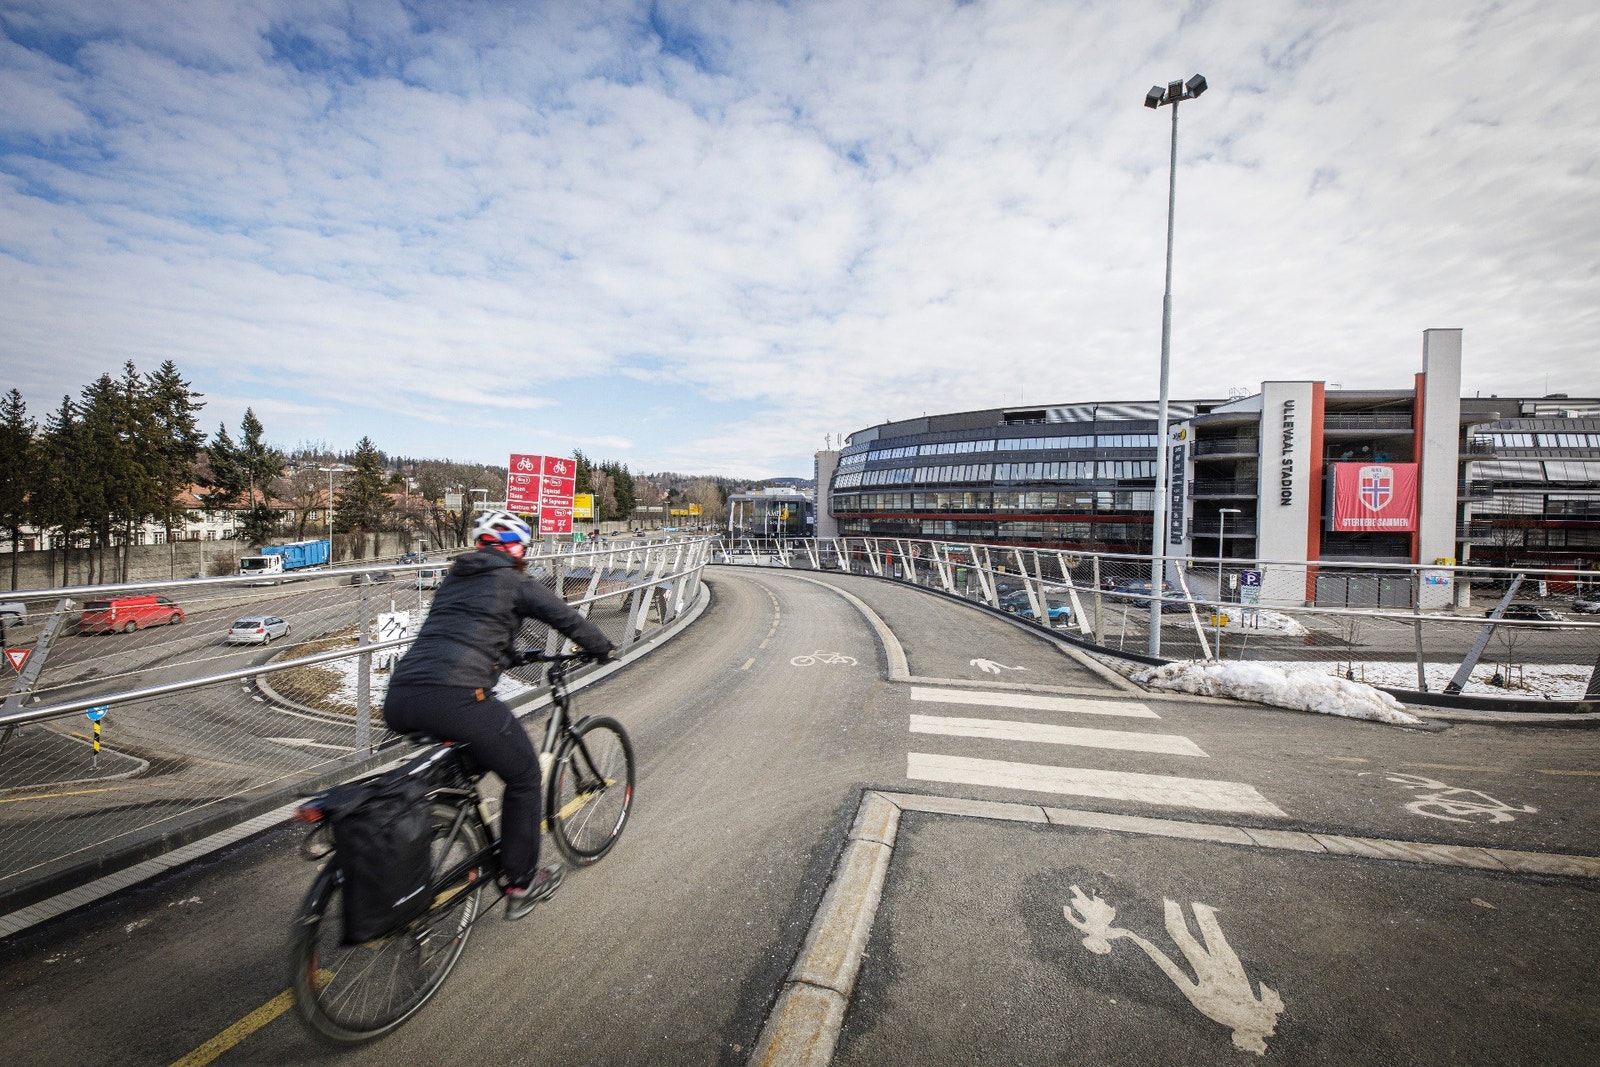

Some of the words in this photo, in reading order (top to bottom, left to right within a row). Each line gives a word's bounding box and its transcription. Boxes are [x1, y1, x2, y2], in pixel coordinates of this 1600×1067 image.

[1282, 399, 1295, 455] ULLEVAAL
[1280, 458, 1293, 506] STADION
[1342, 518, 1375, 527] STERKERE
[1378, 518, 1409, 527] SAMMEN
